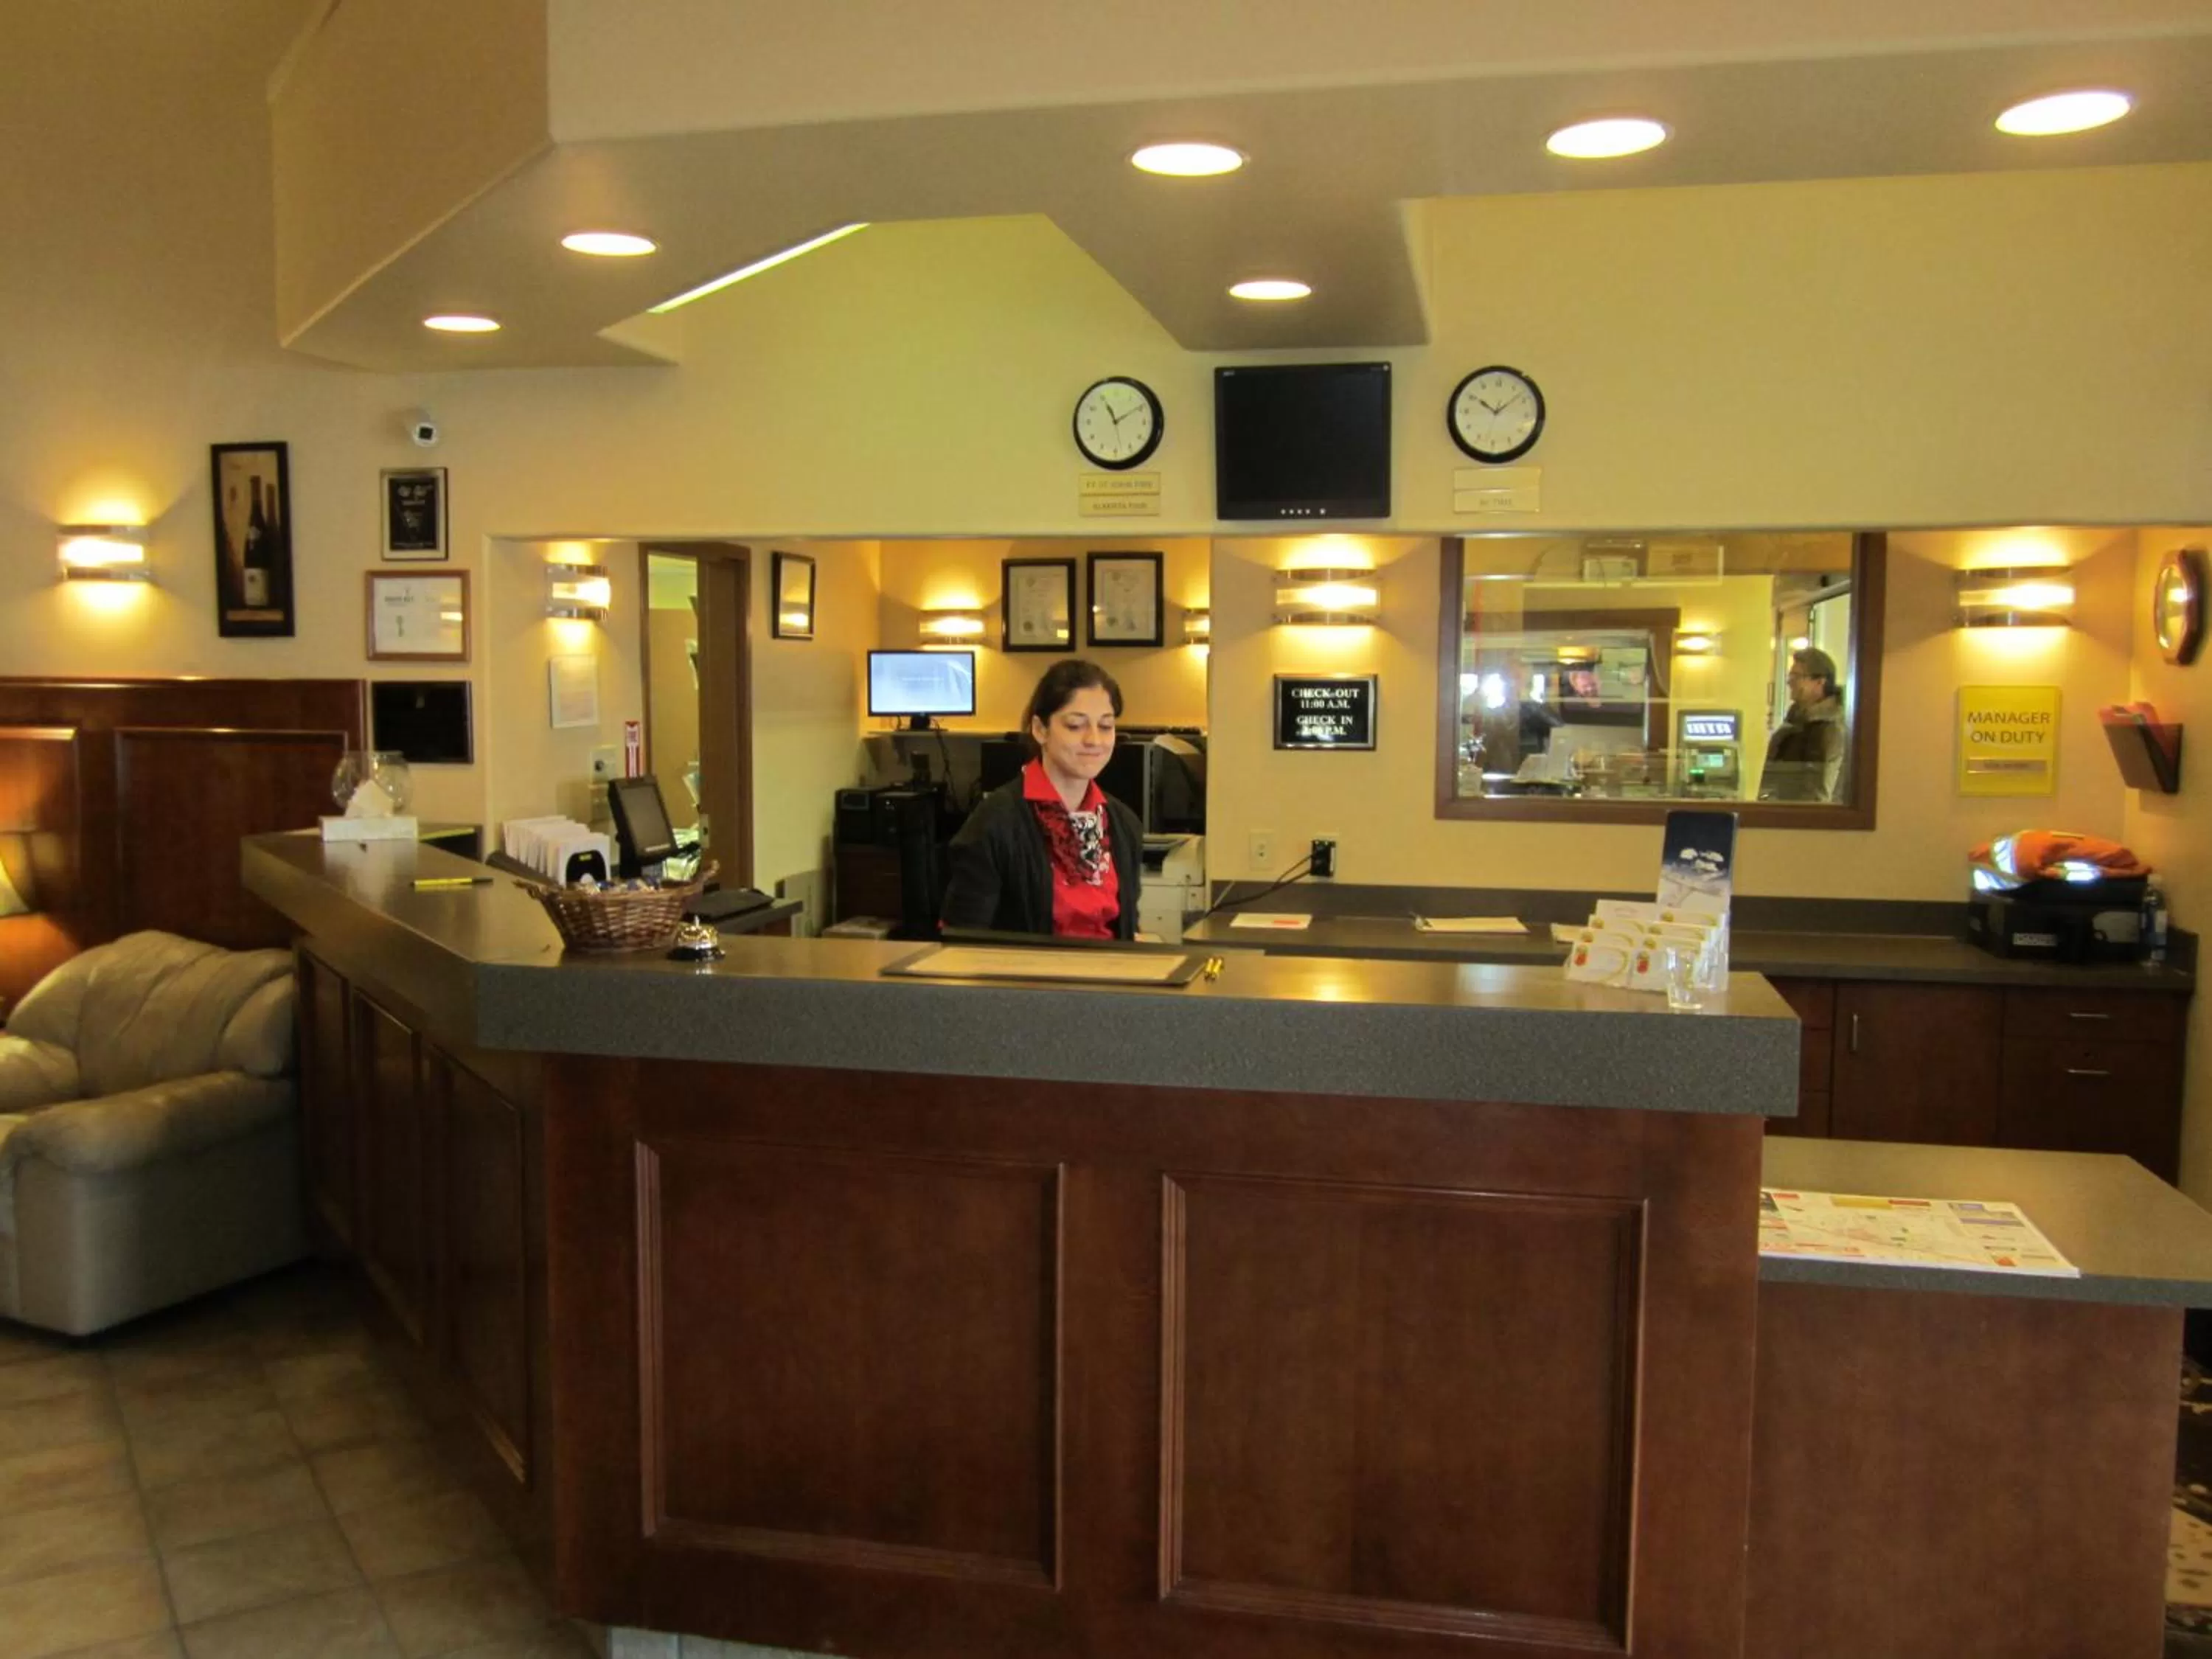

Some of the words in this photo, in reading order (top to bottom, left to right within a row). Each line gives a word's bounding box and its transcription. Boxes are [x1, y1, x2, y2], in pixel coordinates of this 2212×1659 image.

[1301, 699, 1325, 709] 11:00
[1340, 714, 1354, 725] IN
[1967, 711, 2051, 725] MANAGER
[1970, 730, 1996, 744] ON
[2000, 730, 2046, 744] DUTY
